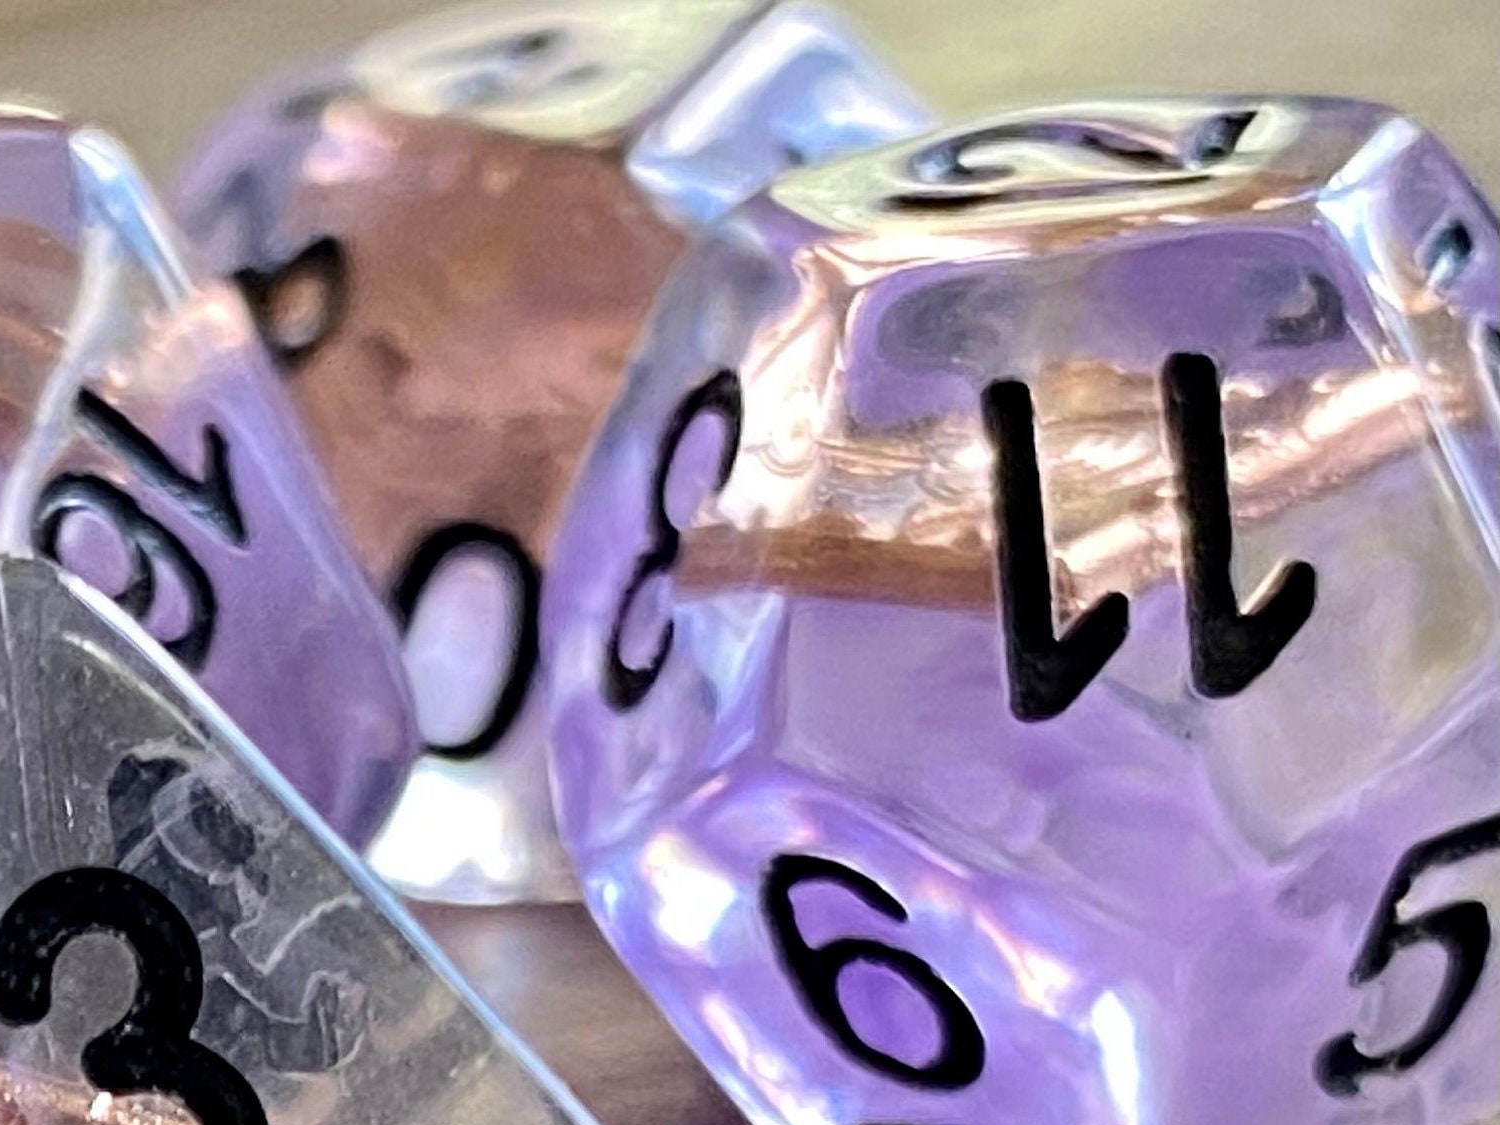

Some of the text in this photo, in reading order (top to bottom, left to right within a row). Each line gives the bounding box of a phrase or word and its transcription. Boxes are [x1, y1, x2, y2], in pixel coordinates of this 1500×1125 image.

[31, 384, 250, 674] 16
[982, 352, 1317, 724] 11
[762, 851, 986, 1092] 6
[1312, 810, 1500, 1098] 5
